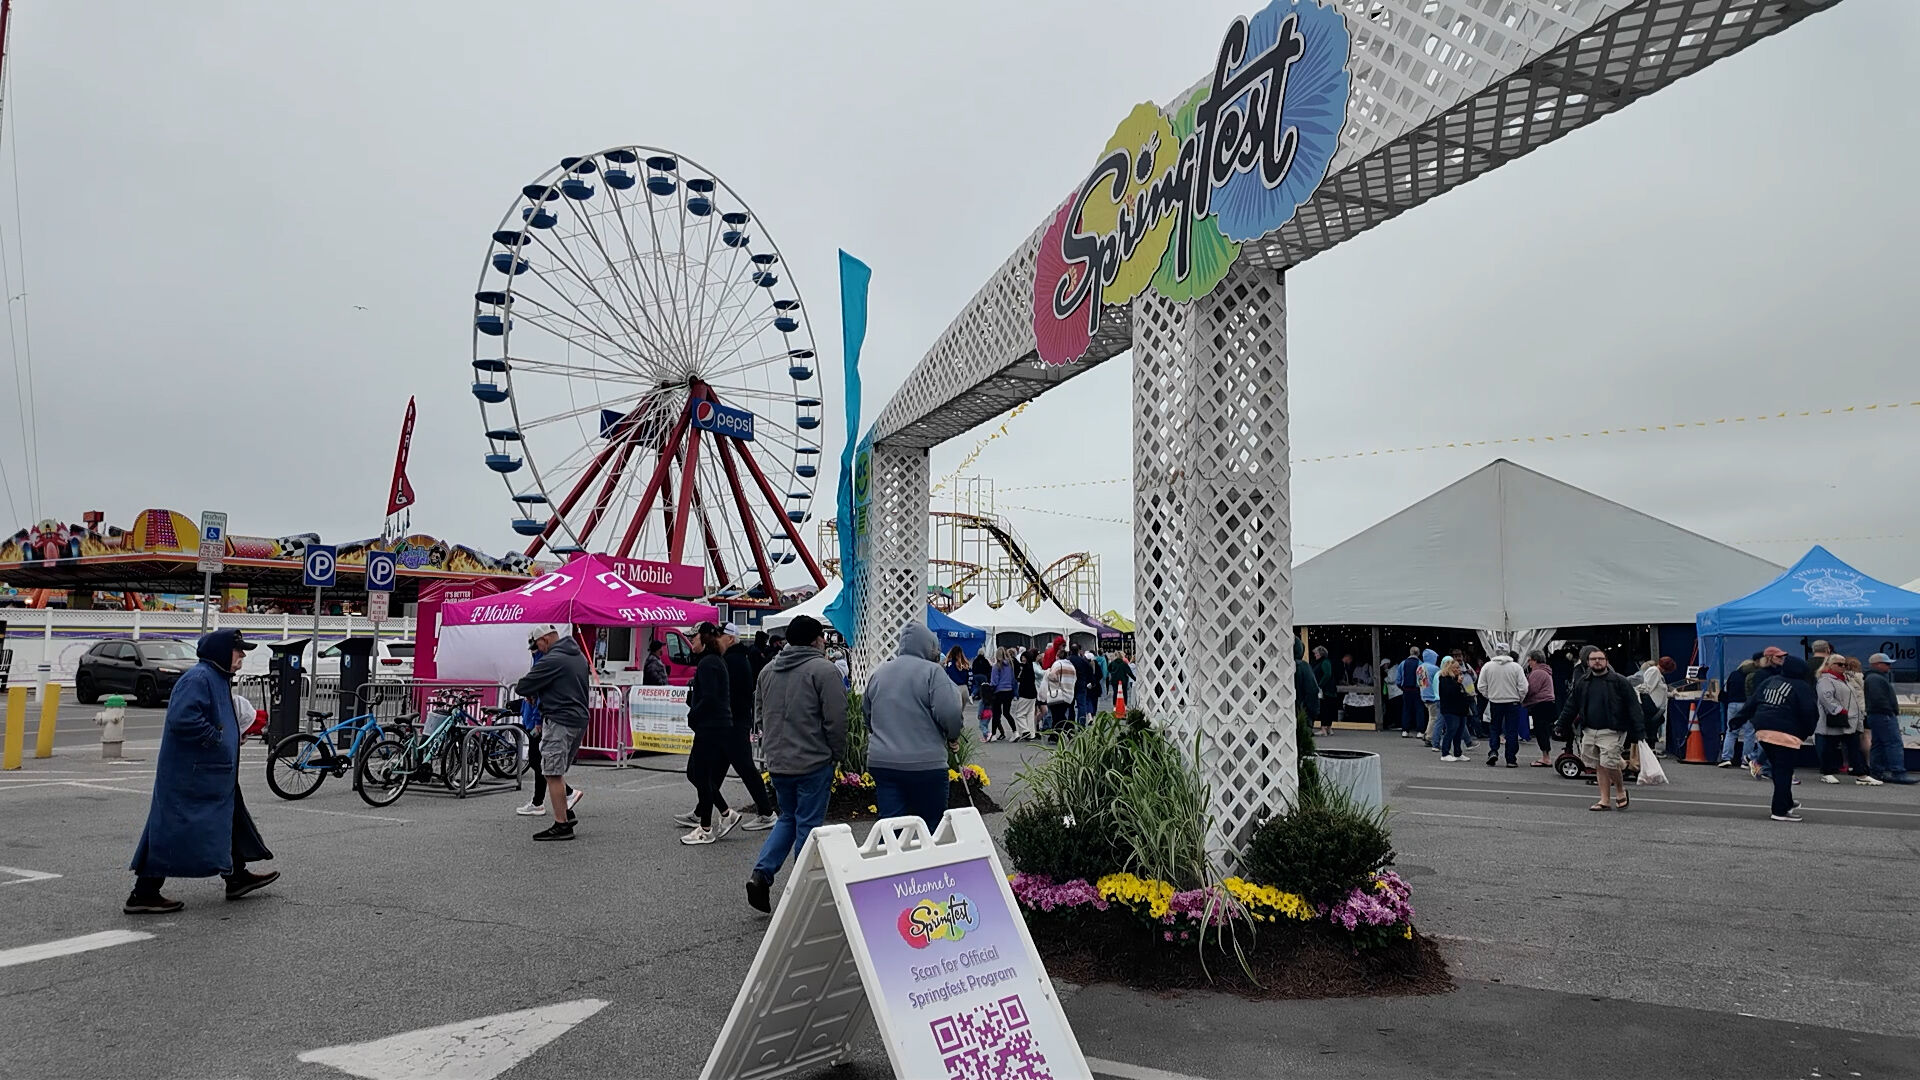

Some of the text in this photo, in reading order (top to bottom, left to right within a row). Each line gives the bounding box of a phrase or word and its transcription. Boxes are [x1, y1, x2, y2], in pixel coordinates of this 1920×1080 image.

[1054, 14, 1304, 336] Springfest
[717, 412, 752, 433] pepsi
[315, 556, 330, 576] P
[376, 561, 390, 580] P
[1781, 613, 1910, 628] Chesapeake Jewelers
[637, 688, 686, 697] PRESERVE OUR
[893, 872, 956, 898] Welcome to
[910, 894, 973, 942] Springfest
[910, 945, 999, 982] Scan for Official
[908, 966, 1017, 1009] Springfest Program
